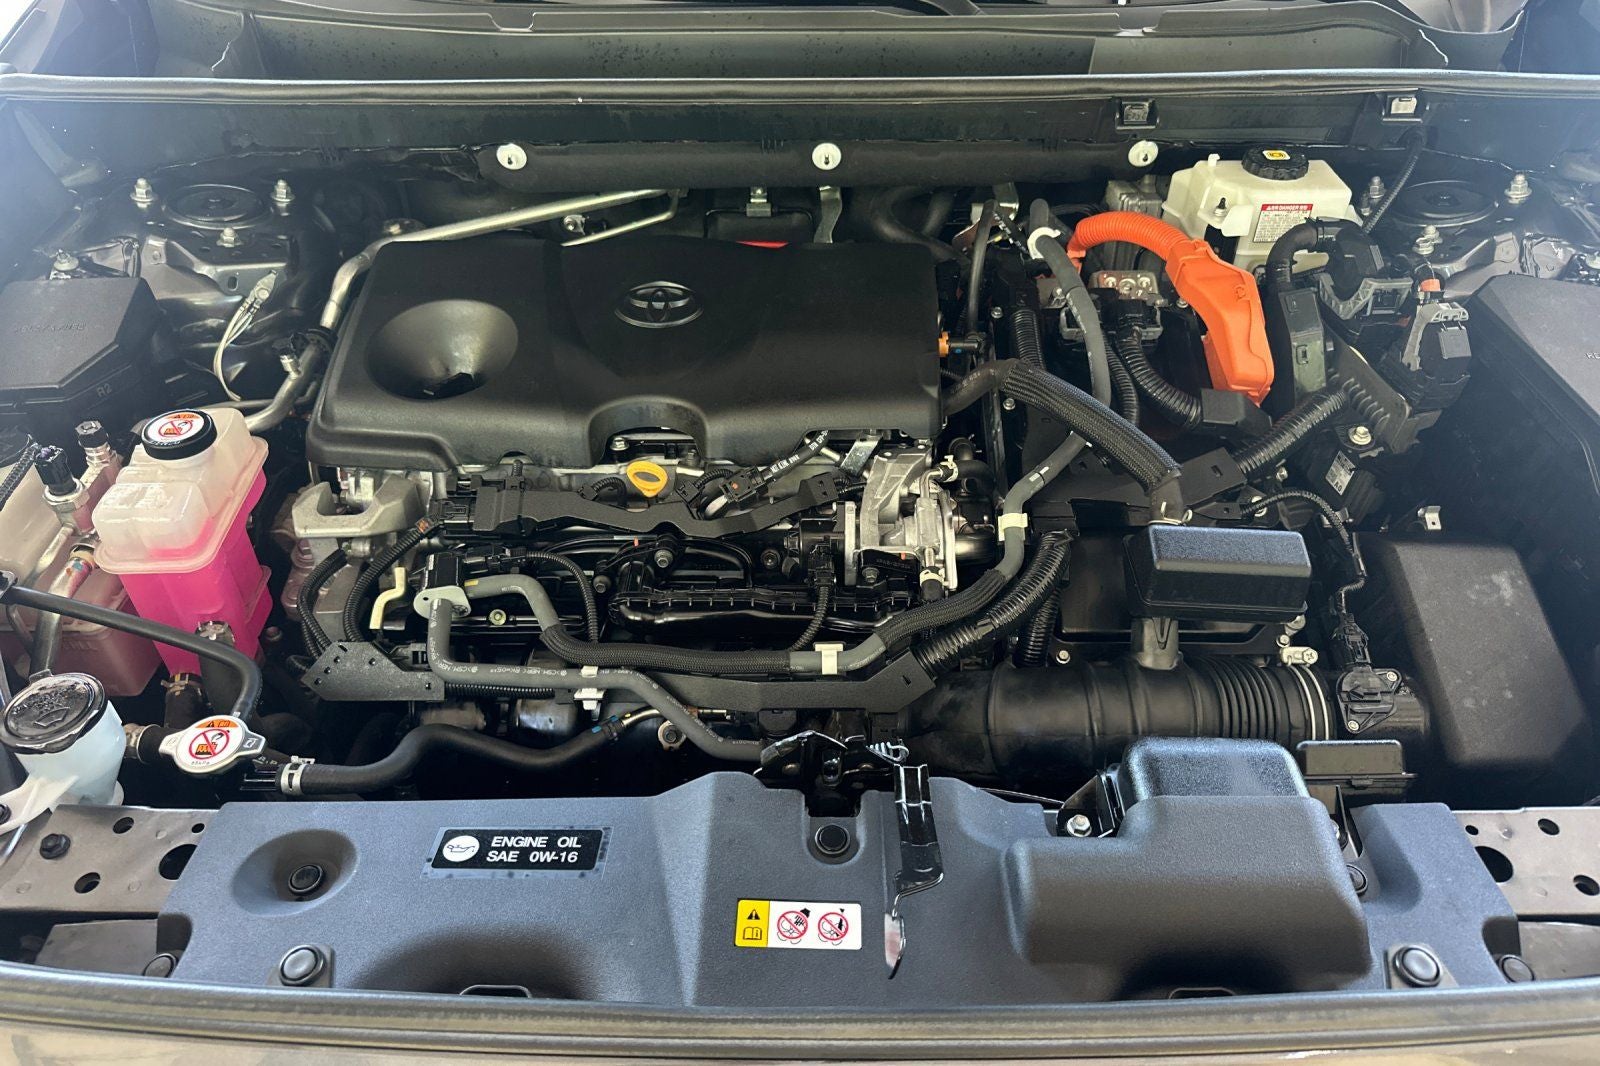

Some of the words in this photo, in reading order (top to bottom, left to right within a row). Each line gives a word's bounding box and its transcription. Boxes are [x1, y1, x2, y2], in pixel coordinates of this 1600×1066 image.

[96, 382, 113, 397] R2
[491, 836, 549, 848] ENGINE
[557, 836, 582, 848] OIL
[486, 851, 520, 863] SAE
[529, 851, 578, 863] 0W-16
